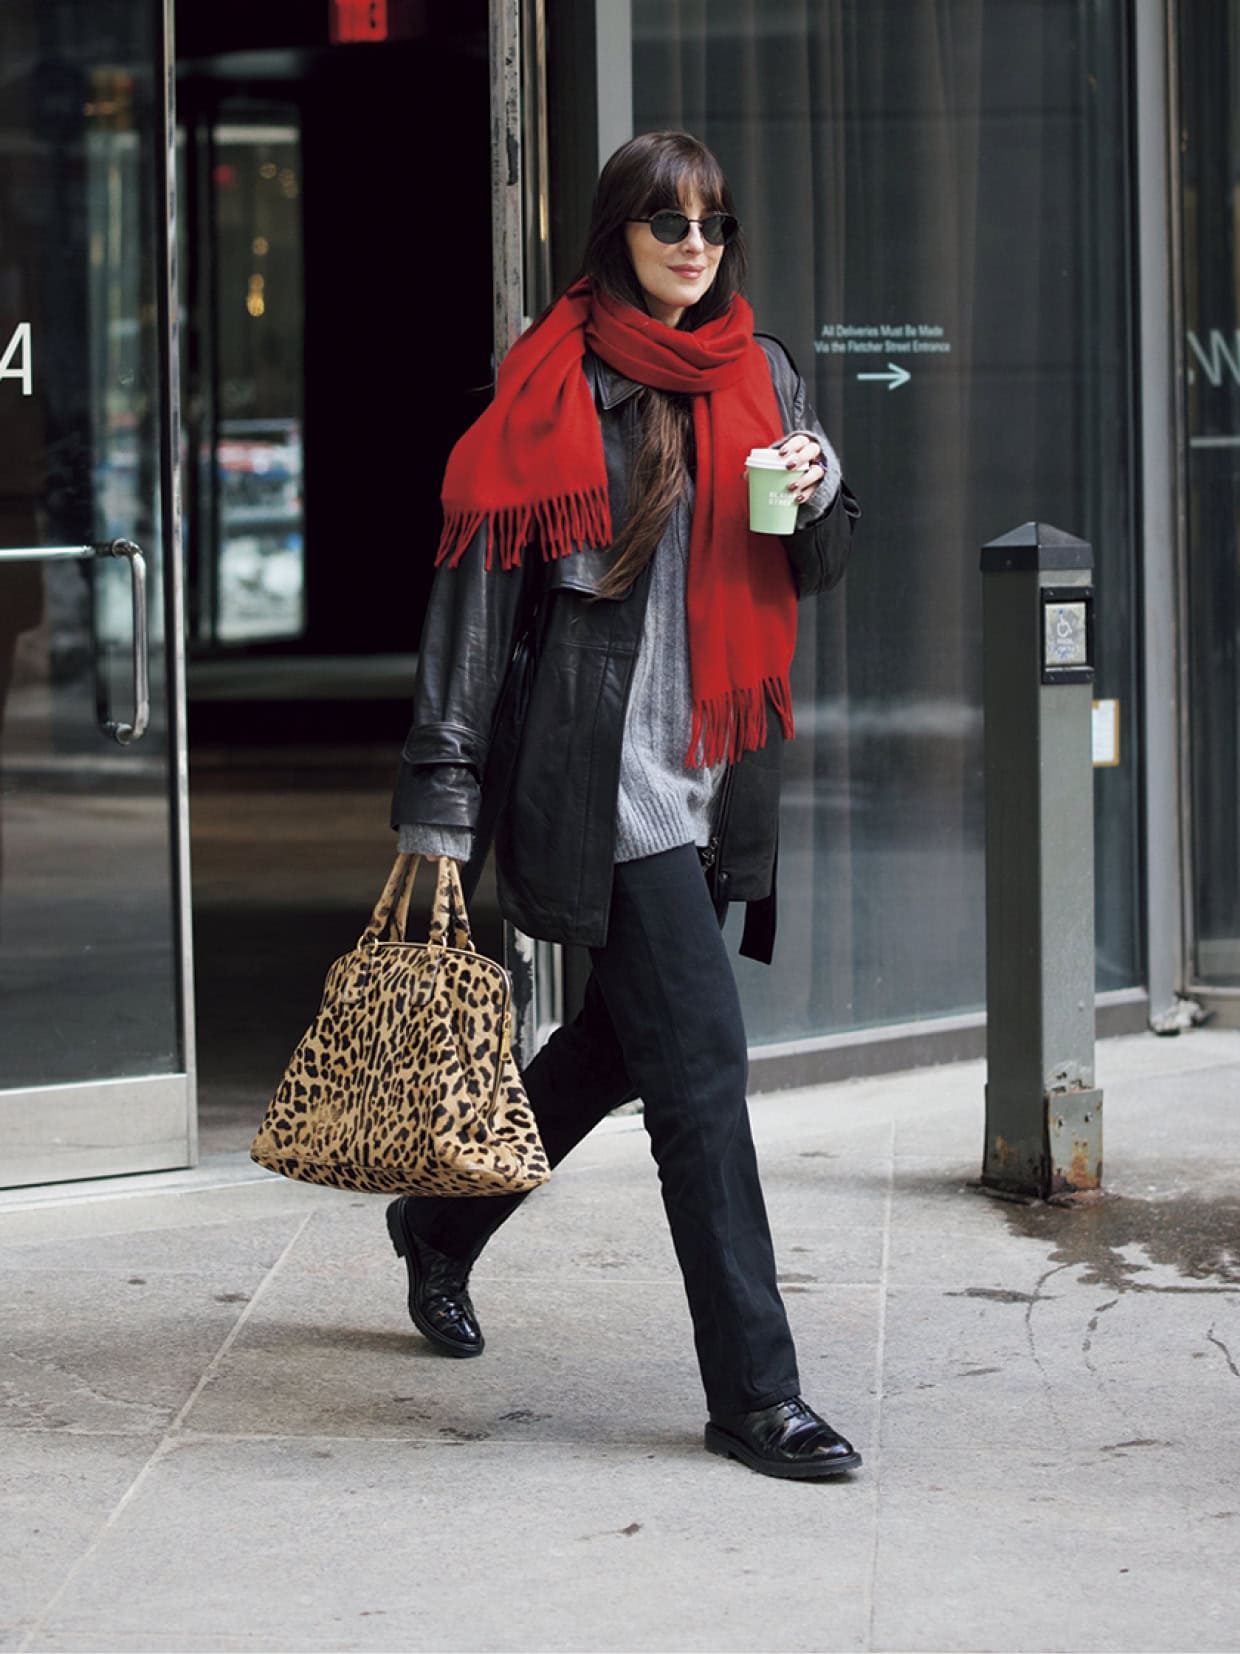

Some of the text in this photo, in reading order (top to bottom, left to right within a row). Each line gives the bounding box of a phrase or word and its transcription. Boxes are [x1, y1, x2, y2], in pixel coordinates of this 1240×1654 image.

[822, 325, 943, 337] All Deliveries Must Be Made
[814, 341, 950, 353] Via the Fletcher Street Entrance
